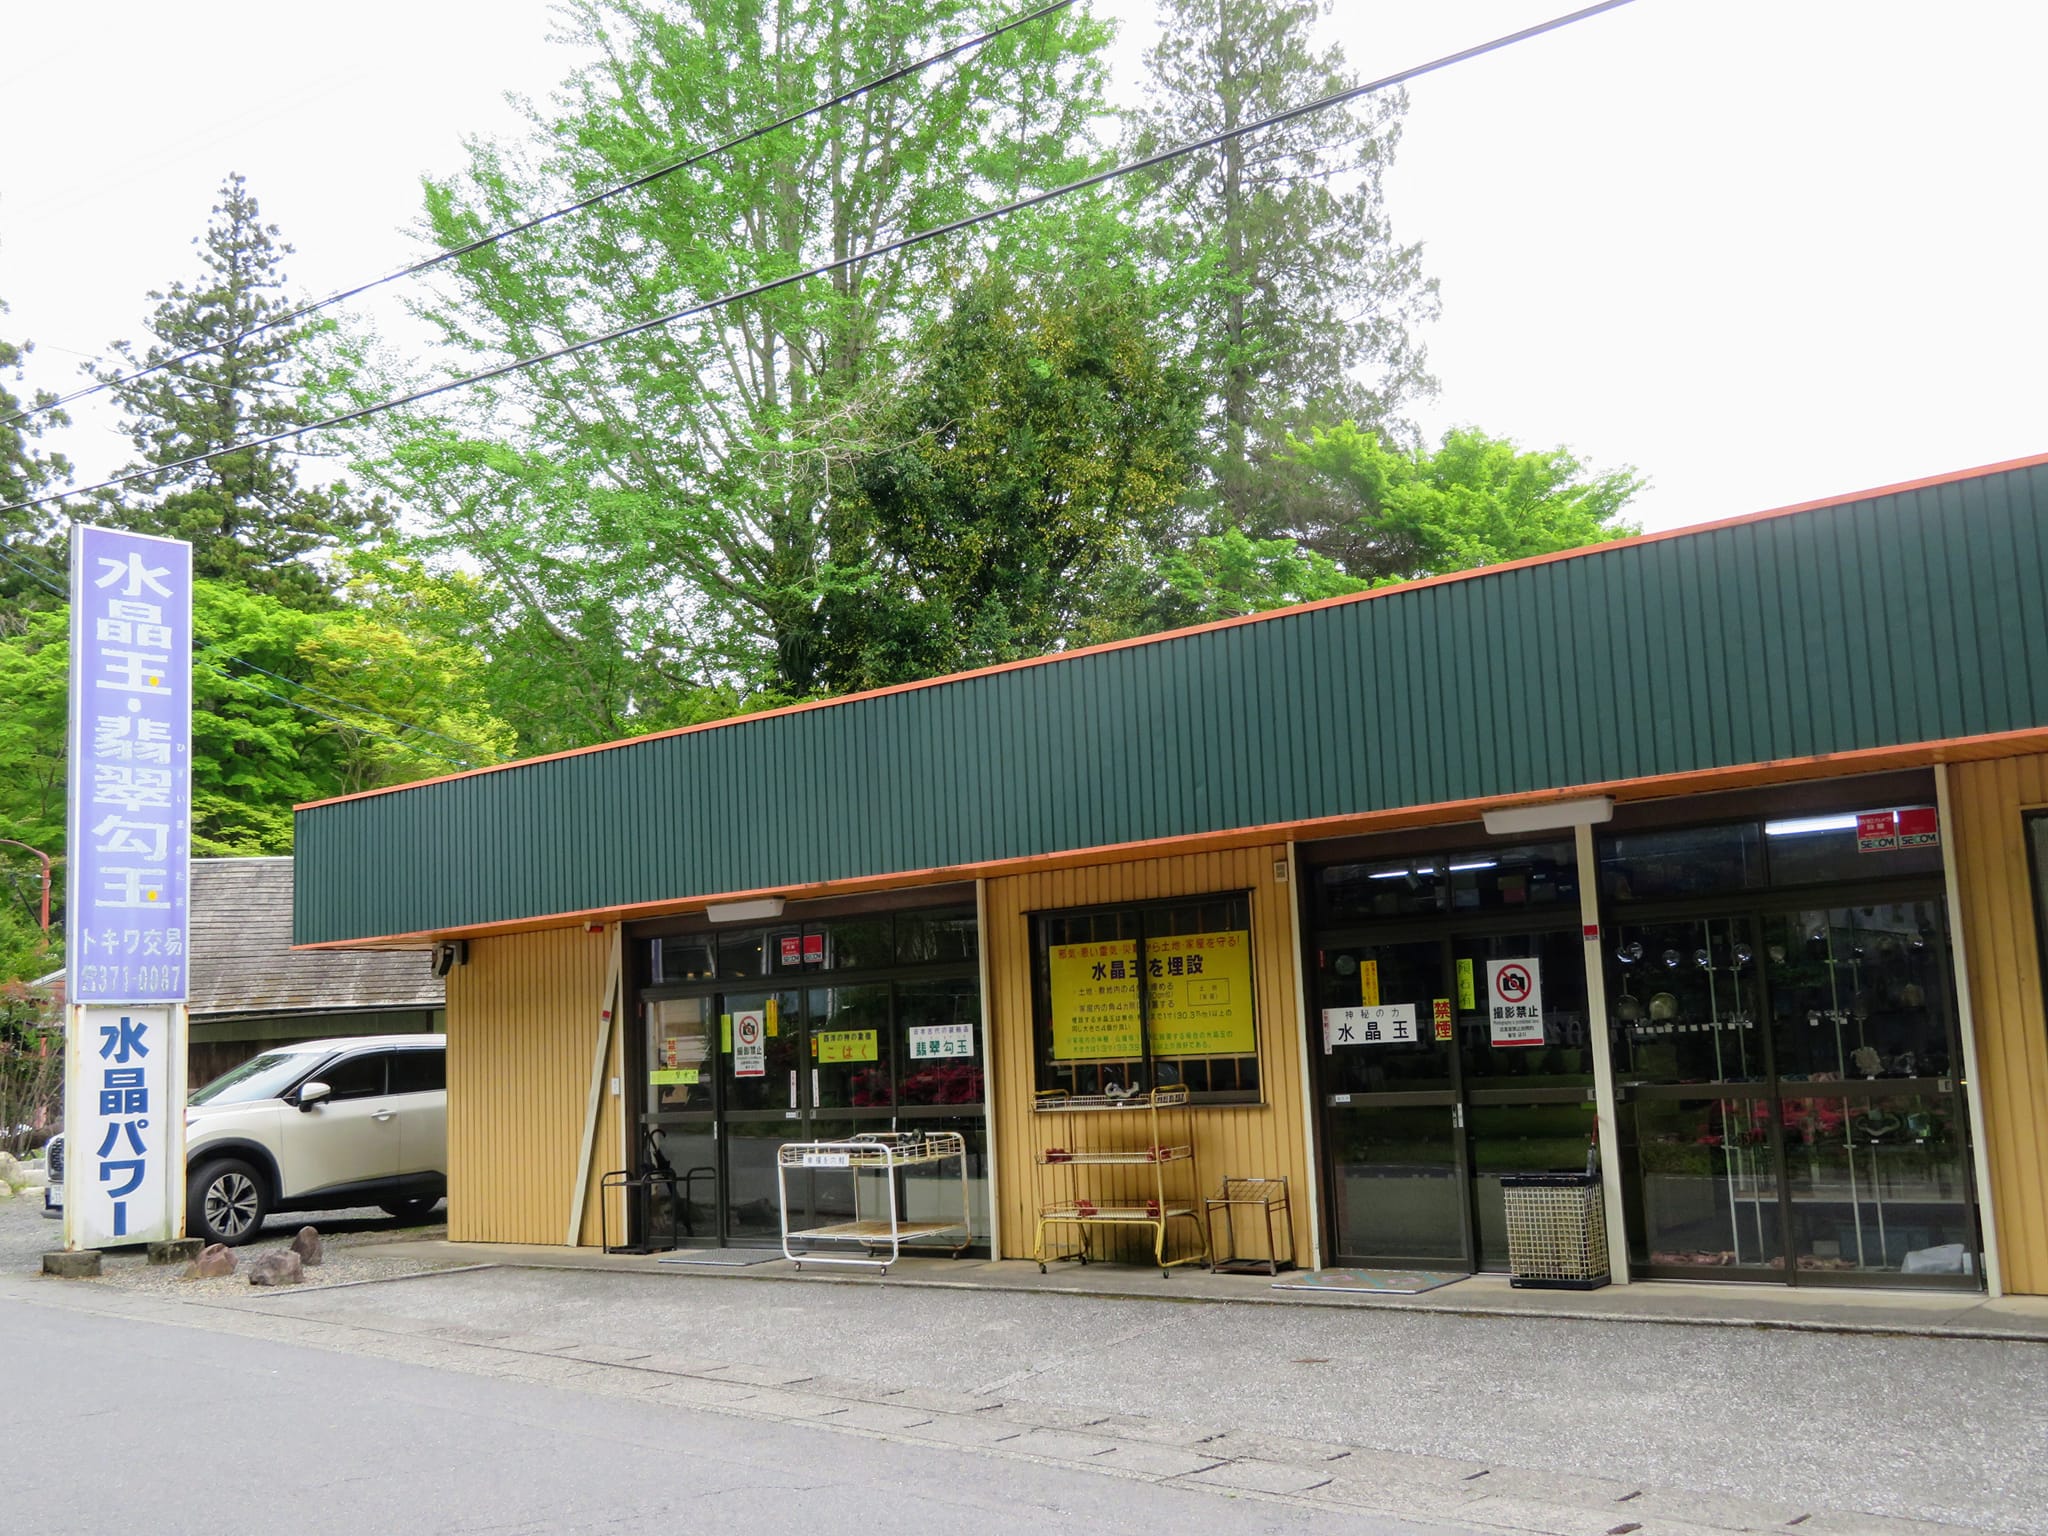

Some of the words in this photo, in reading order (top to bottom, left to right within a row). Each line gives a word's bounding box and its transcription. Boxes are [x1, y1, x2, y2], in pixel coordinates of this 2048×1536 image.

[91, 552, 174, 909] 水晶玉・翡翠勾玉
[1861, 838, 1895, 848] SECOM
[1901, 834, 1936, 844] SECOM
[83, 928, 183, 956] トキワ交易
[1345, 1008, 1400, 1020] 神秘の力
[1434, 1001, 1452, 1038] 禁煙
[1493, 1005, 1539, 1020] 撮影禁止
[1337, 1020, 1410, 1042] 水晶玉
[827, 1044, 867, 1059] こはく
[916, 1039, 968, 1057] 翡翠勾玉
[99, 1016, 150, 1237] 水晶パワー
